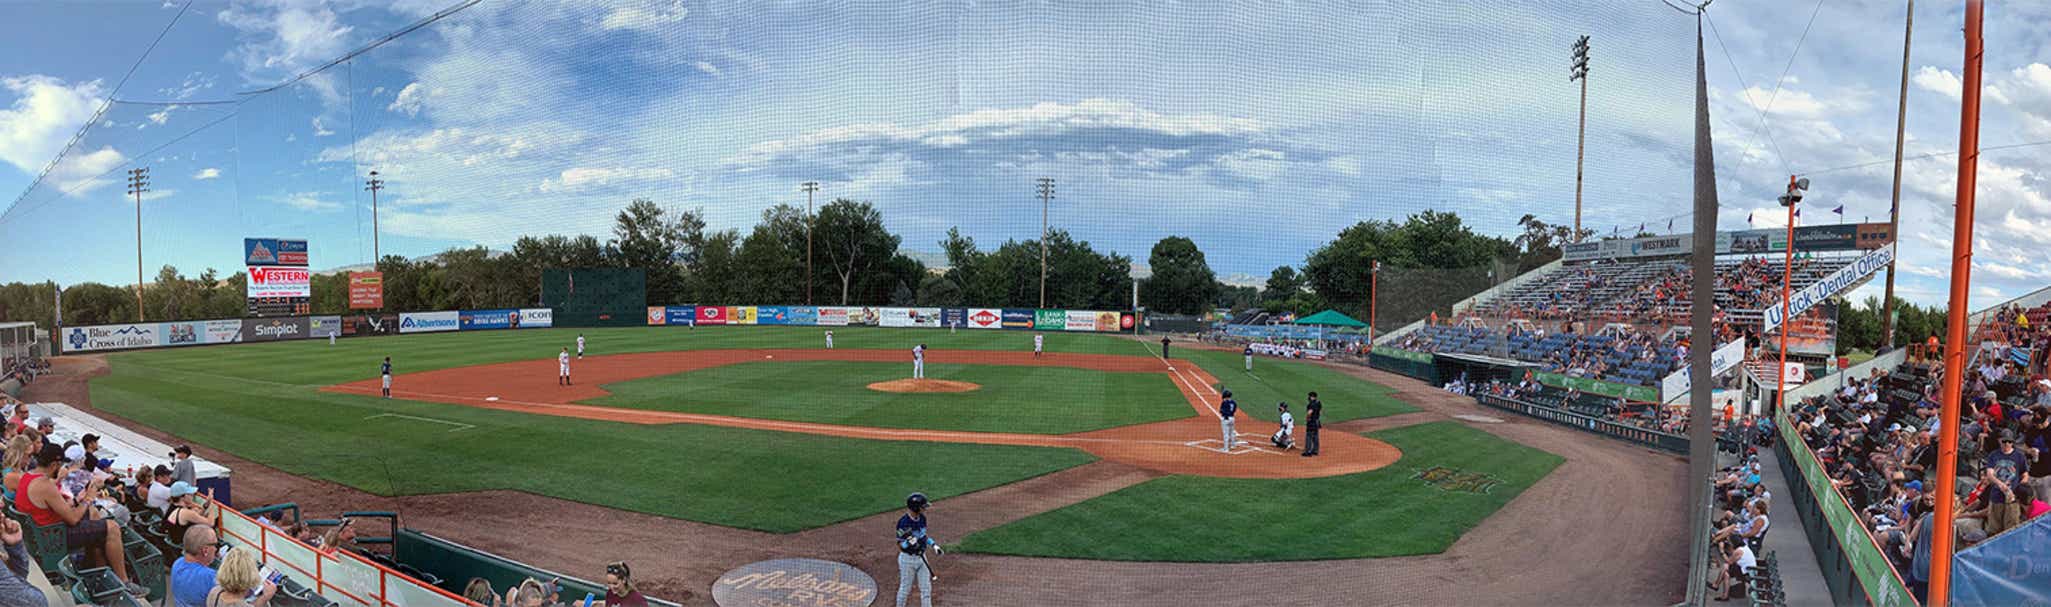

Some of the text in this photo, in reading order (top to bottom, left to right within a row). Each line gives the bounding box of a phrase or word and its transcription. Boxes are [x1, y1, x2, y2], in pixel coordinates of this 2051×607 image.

[1641, 237, 1680, 250] WESTMARK
[249, 267, 309, 284] WESTERN
[1769, 249, 1891, 325] Utick Dental Office
[89, 328, 111, 338] Blue
[255, 324, 298, 338] Simplot
[89, 336, 153, 349] Cross of Idaho
